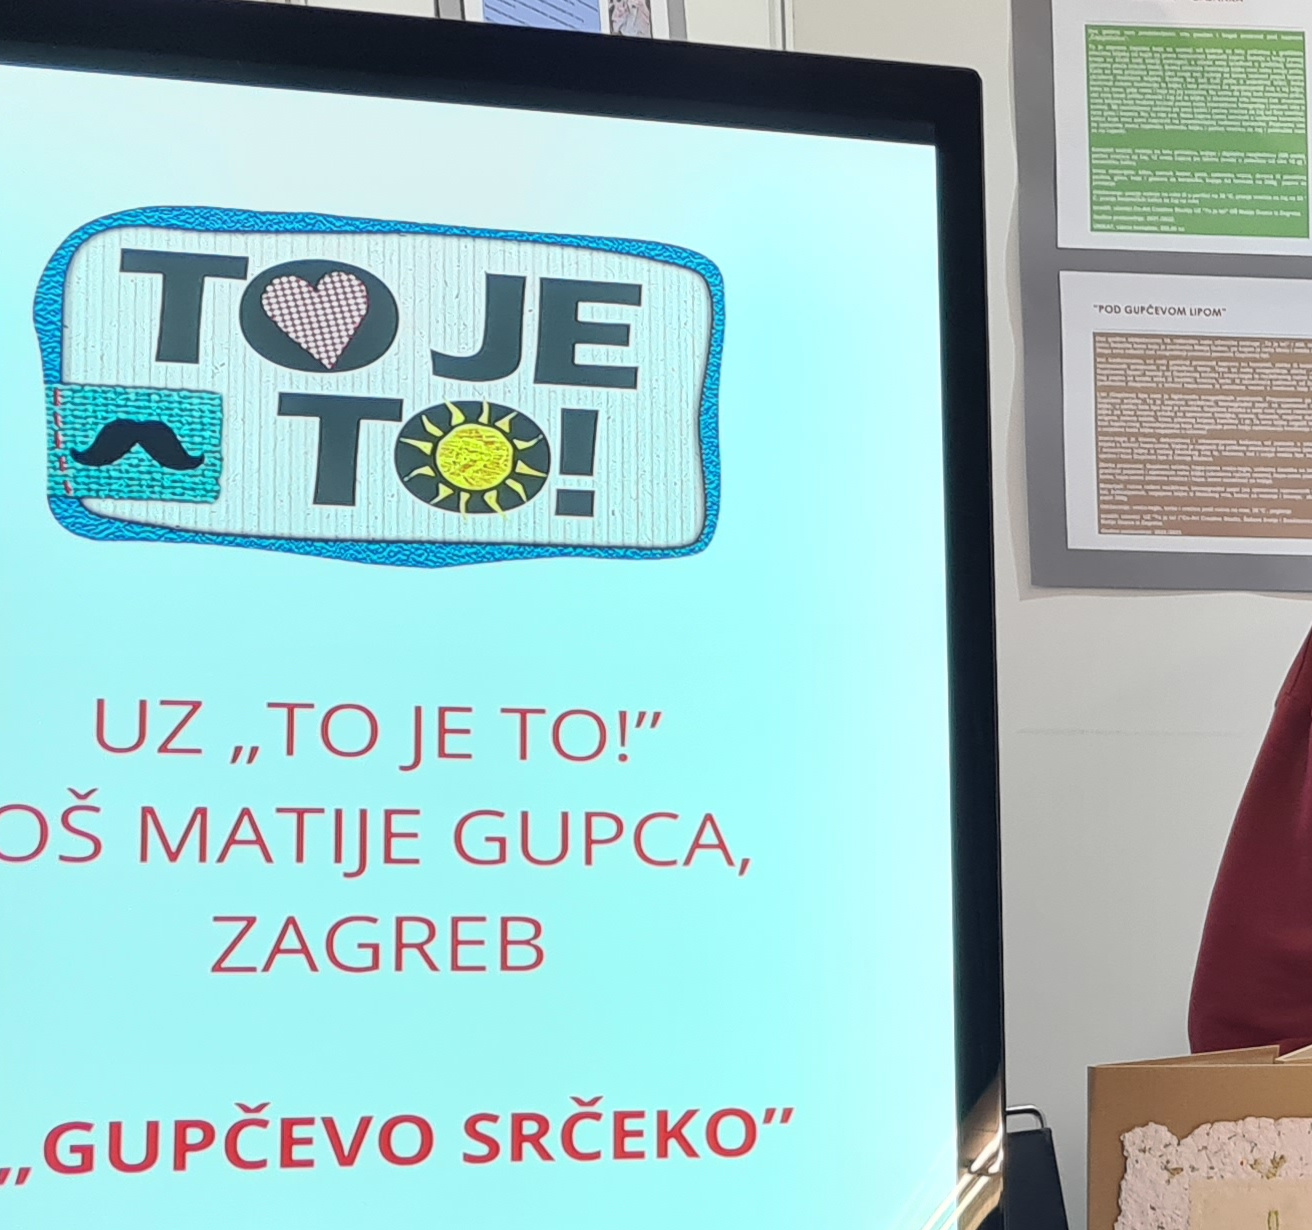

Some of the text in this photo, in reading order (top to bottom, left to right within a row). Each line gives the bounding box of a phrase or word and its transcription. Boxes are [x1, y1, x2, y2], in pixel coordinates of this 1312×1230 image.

[120, 248, 643, 391] TO JE
[1124, 303, 1187, 316] GUPČEVOM
[277, 391, 600, 517] TO!
[94, 698, 203, 755] UZ
[229, 700, 380, 767] „TO
[398, 704, 474, 773] JE
[0, 788, 752, 880] OŠ MATIJE GUPCA,
[210, 914, 546, 973] ZAGREB
